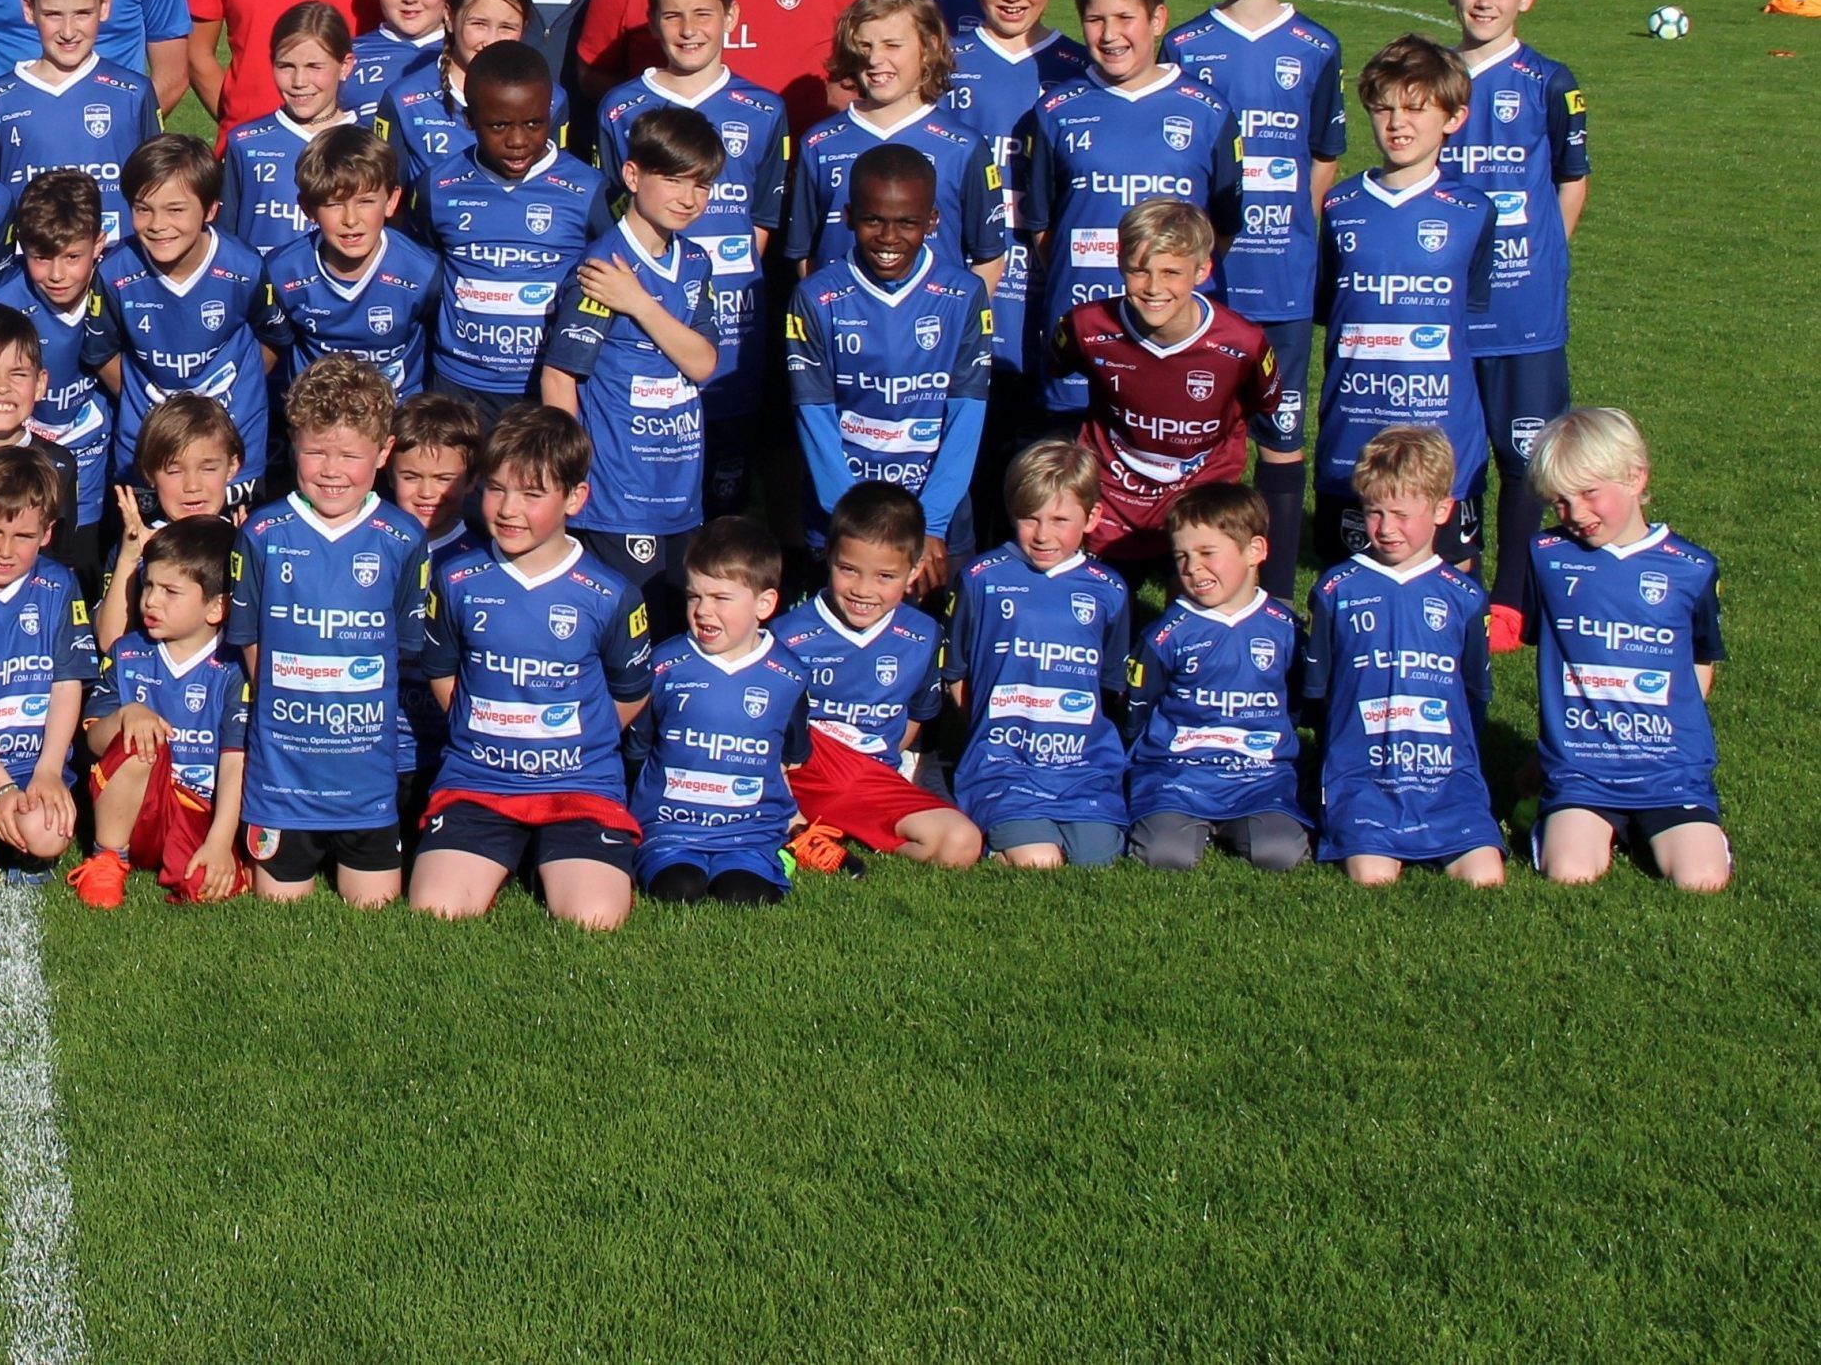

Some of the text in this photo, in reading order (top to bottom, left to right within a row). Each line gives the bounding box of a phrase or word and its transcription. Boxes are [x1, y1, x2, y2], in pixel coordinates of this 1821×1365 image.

[1172, 24, 1214, 45] WOLF
[354, 66, 384, 86] 12
[947, 87, 972, 110] 13
[1044, 87, 1086, 111] WOLF
[9, 125, 22, 147] 4
[422, 132, 449, 155] 12
[1064, 131, 1092, 154] 14
[253, 163, 277, 184] 12
[830, 166, 843, 189] 5
[1092, 172, 1192, 206] typico
[457, 212, 472, 232] 2
[1335, 231, 1357, 253] 13
[1353, 271, 1453, 304] typico
[138, 314, 152, 334] 4
[834, 333, 861, 355] 10
[859, 372, 949, 405] typico
[1110, 374, 1120, 392] 1
[1408, 397, 1449, 408] Partner
[1124, 408, 1220, 441] typico
[253, 513, 295, 534] WOLF
[281, 562, 293, 584] 8
[448, 562, 494, 581] WOLF
[1565, 576, 1579, 596] 7
[1000, 598, 1014, 619] 9
[292, 603, 385, 639] typico
[473, 610, 487, 633] 2
[1349, 610, 1375, 634] 10
[1579, 615, 1674, 650] typico
[1014, 637, 1099, 671] typico
[273, 663, 344, 680] obwegeser
[485, 650, 579, 687] typico
[811, 668, 834, 685] 10
[1184, 656, 1199, 675] 5
[136, 685, 148, 703] 5
[677, 693, 690, 712] 7
[1195, 687, 1279, 717] typico
[272, 700, 384, 726] SCHORM
[823, 698, 903, 724] typico
[1565, 708, 1672, 735] SCHORM
[346, 721, 384, 734] Partner
[272, 732, 351, 746] Versichern. Optimieren.
[685, 728, 769, 760] typico
[987, 726, 1087, 754] SCHORM
[1416, 763, 1452, 774] Partner
